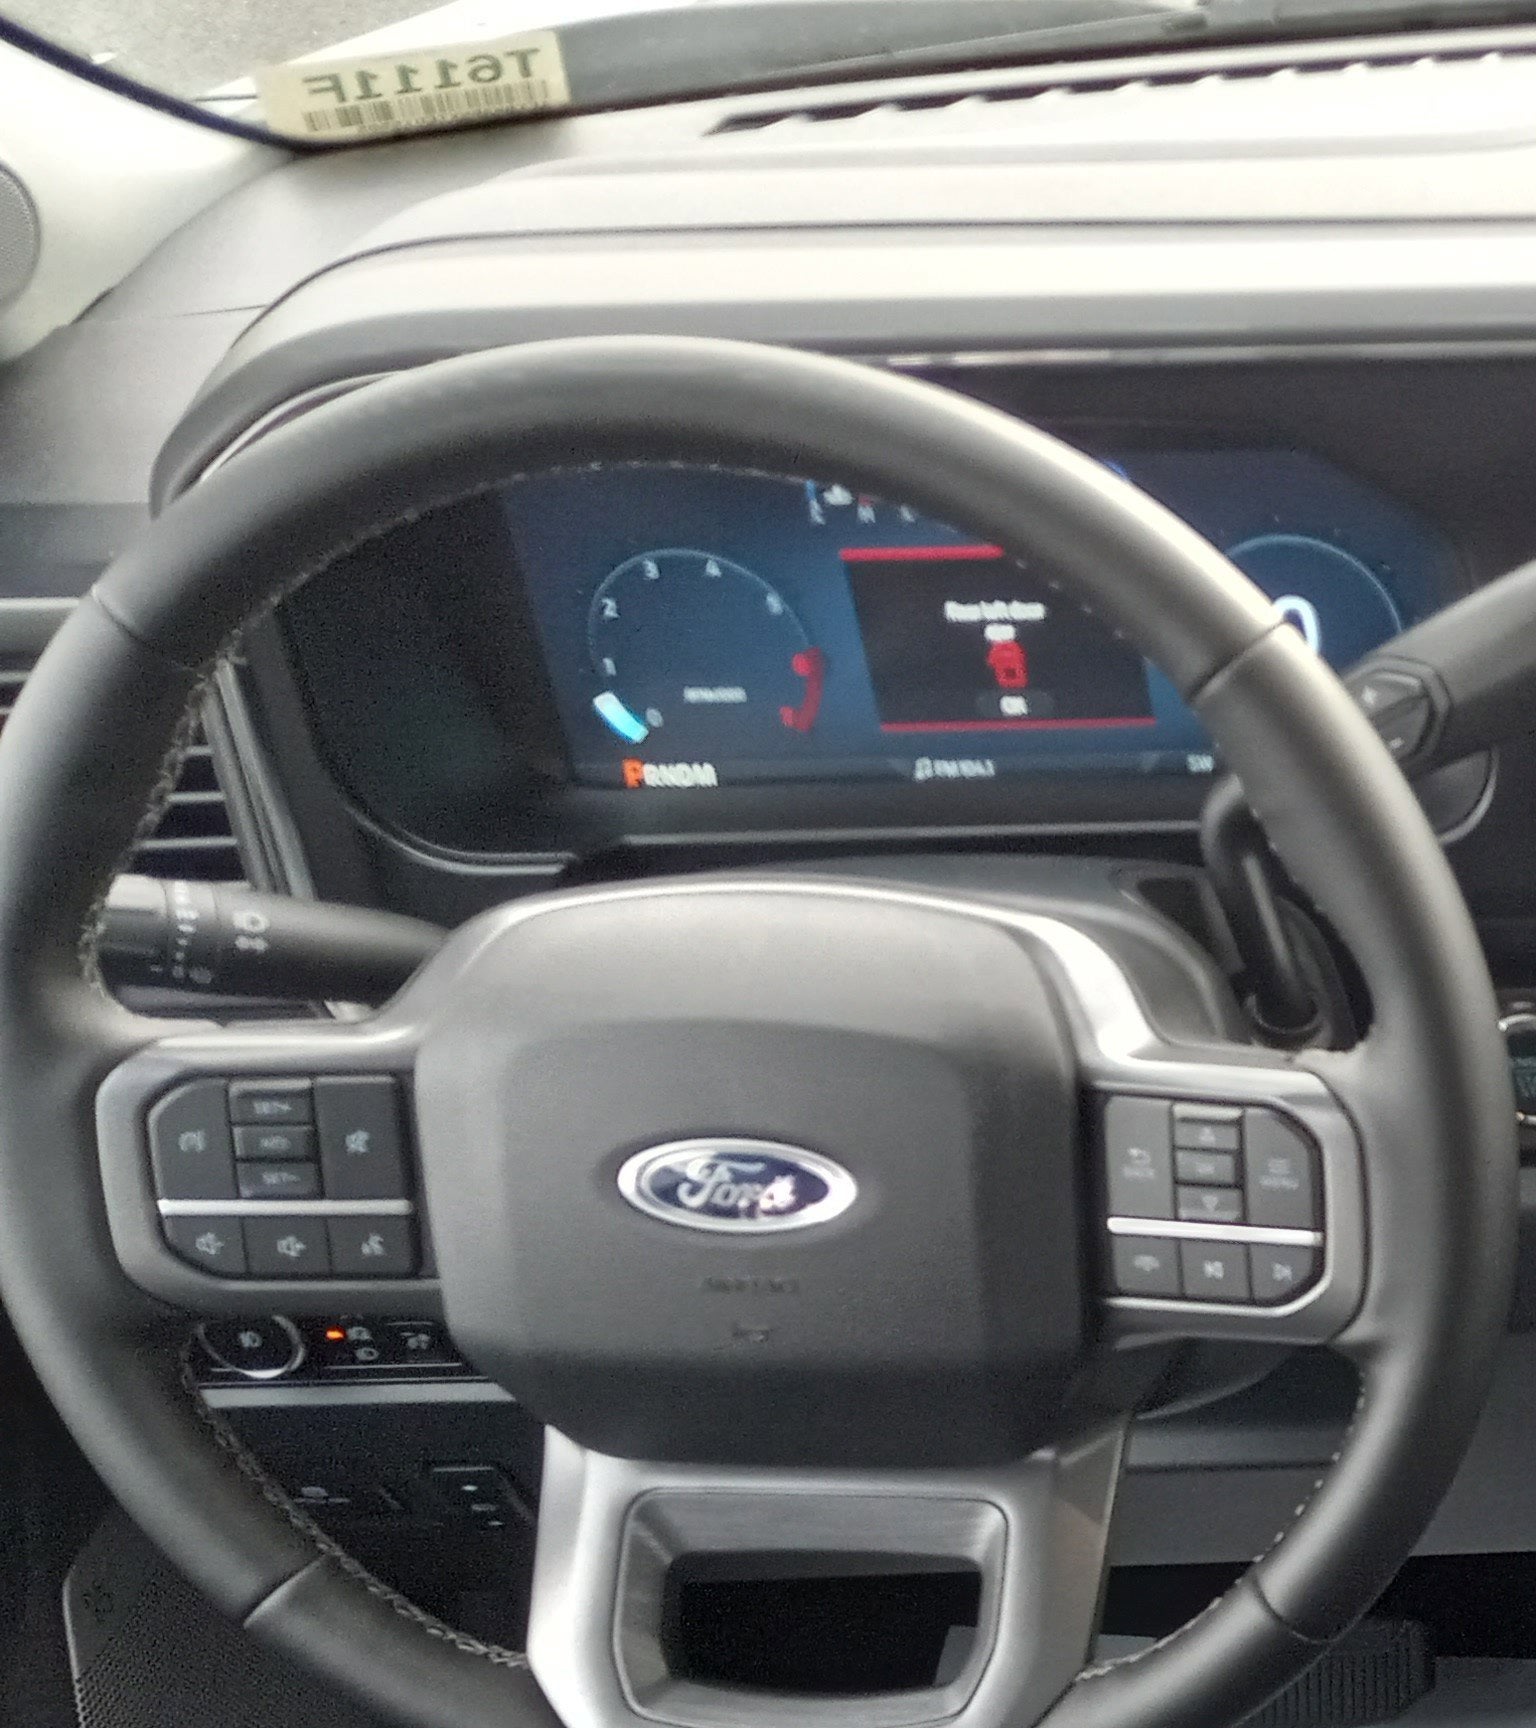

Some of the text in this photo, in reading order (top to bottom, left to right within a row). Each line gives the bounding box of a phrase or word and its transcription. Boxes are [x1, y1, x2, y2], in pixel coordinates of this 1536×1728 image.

[645, 559, 660, 579] 3
[602, 597, 619, 619] 2
[675, 1153, 797, 1212] Ford
